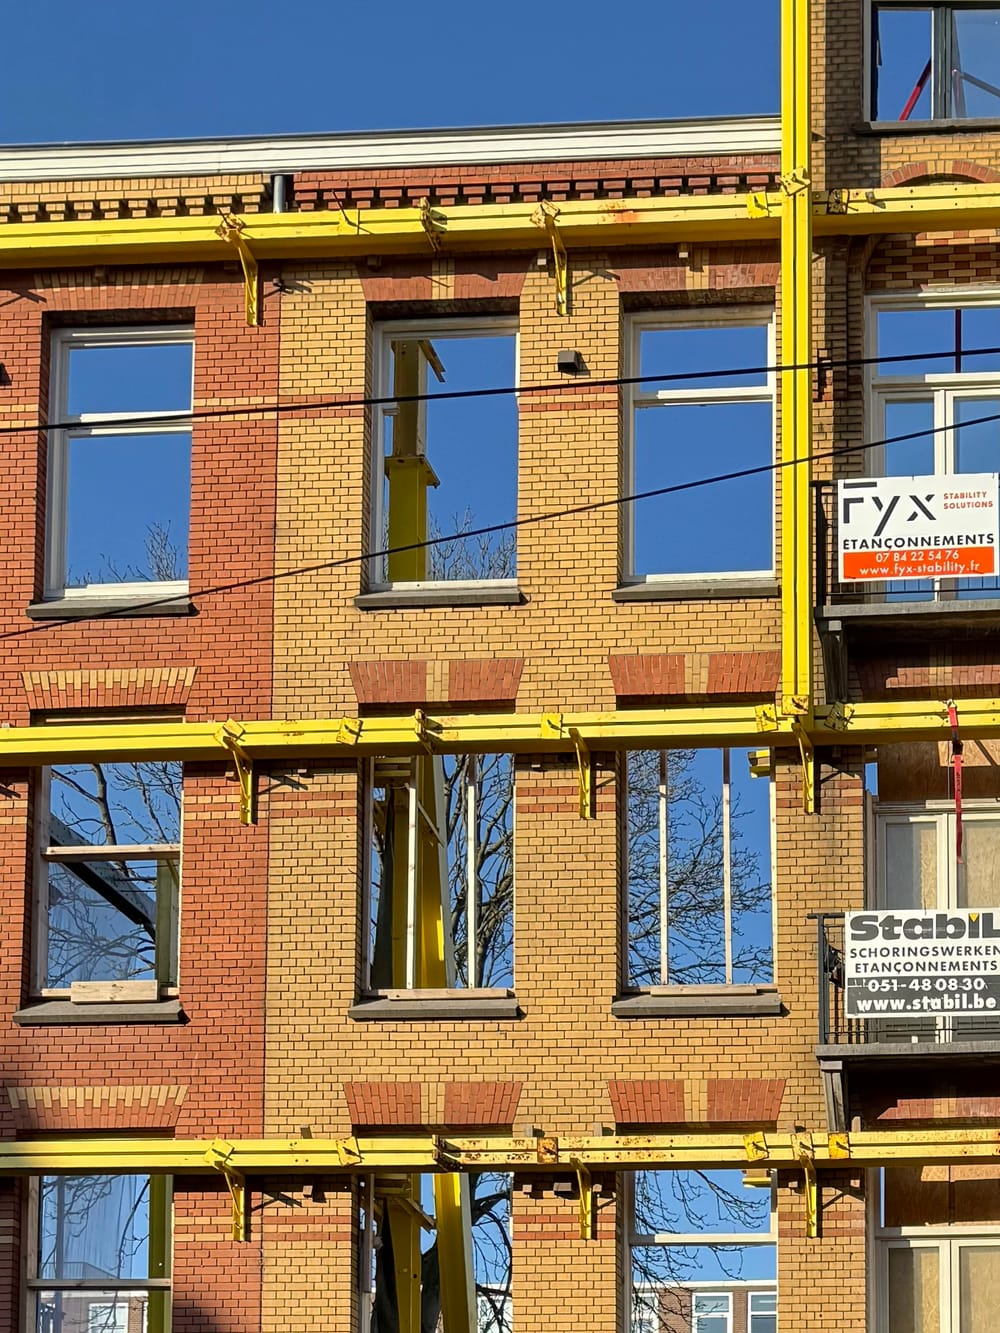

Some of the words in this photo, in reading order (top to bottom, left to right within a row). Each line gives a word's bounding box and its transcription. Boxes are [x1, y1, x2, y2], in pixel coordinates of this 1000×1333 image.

[943, 491, 987, 500] STABILITY
[943, 501, 993, 510] SOLUTIONS
[876, 552, 889, 563] 07
[894, 551, 907, 562] 84
[910, 551, 924, 561] 22
[928, 550, 941, 561] 54
[945, 550, 959, 560] 76
[859, 560, 981, 577] www.fyx-stability.fr
[855, 960, 998, 974] ETANÇONNEMENTS
[856, 993, 997, 1011] www.stabil.be
